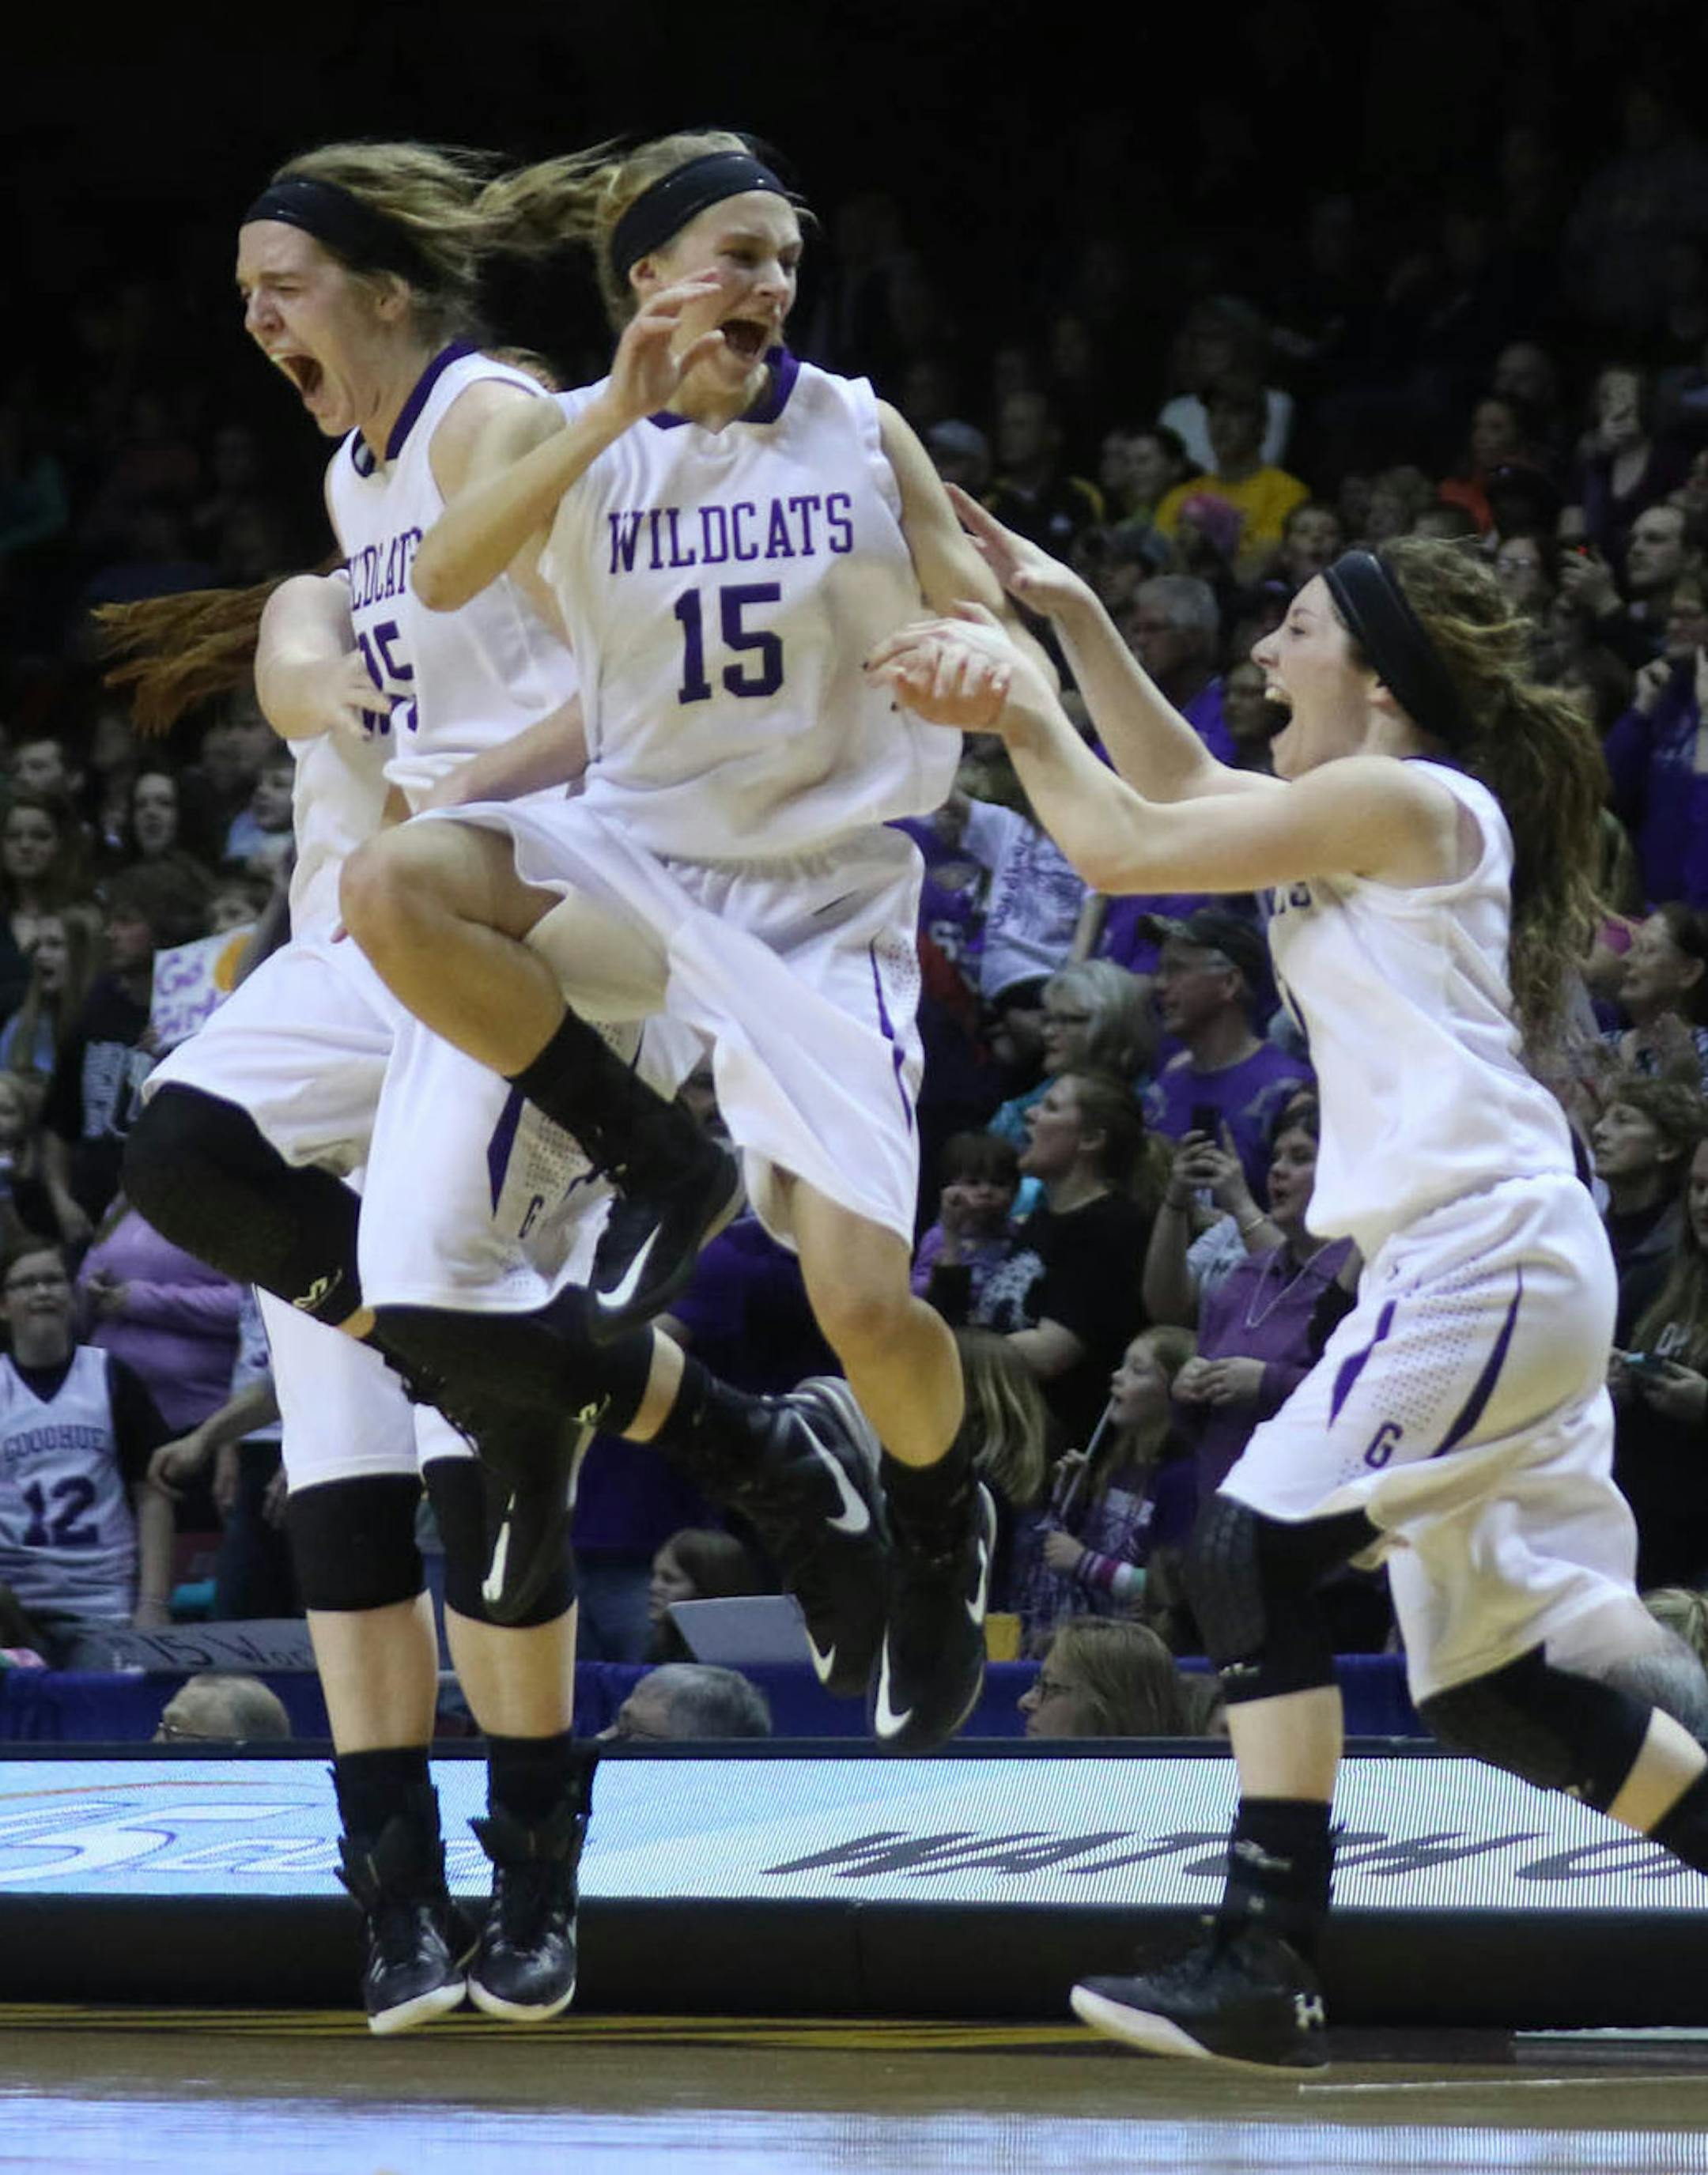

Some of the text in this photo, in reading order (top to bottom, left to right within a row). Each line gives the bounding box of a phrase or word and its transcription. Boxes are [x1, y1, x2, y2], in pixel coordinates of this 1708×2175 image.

[609, 493, 852, 574] WILDCATS
[674, 582, 784, 704] 15
[518, 1193, 545, 1240] G
[3, 1425, 111, 1463] GOODHUE
[1364, 1421, 1403, 1469] G
[23, 1476, 99, 1546] 12
